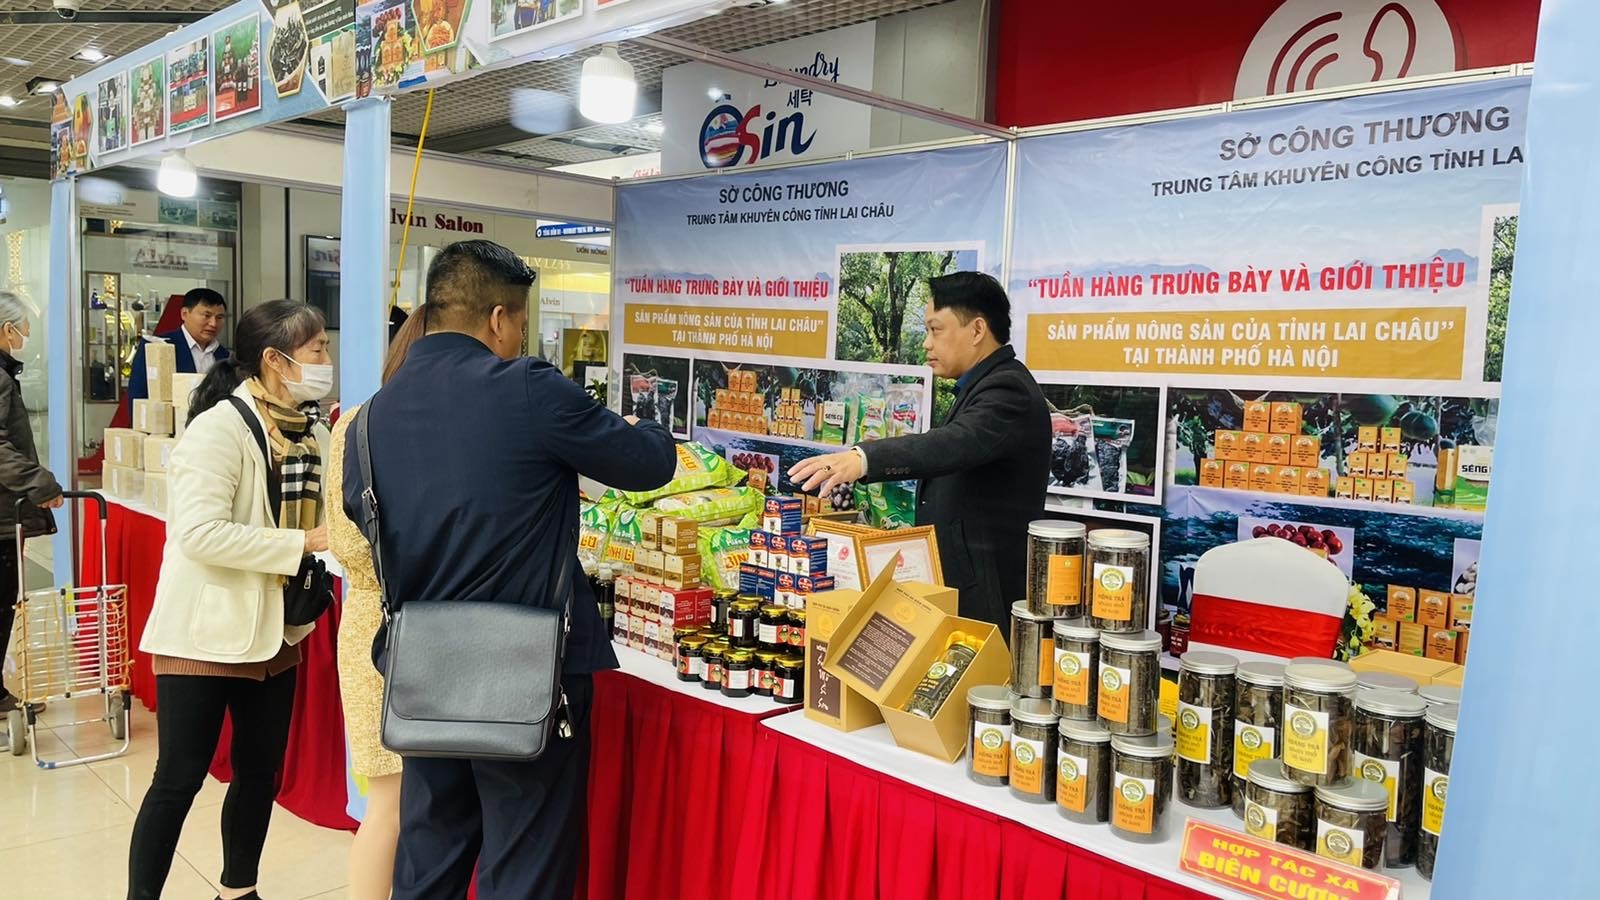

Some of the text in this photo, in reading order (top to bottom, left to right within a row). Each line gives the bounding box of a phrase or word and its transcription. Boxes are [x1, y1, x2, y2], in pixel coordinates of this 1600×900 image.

[787, 88, 813, 108] 세탁
[1219, 106, 1510, 160] SỞ CÔNG THƯƠNG
[1152, 146, 1524, 196] TRUNG TÂM KHUYÊN CÔNG TỈNH LA
[719, 180, 848, 203] SỞ CÔNG THƯƠNG
[391, 208, 484, 233] lvin Salon
[687, 213, 716, 225] TRUNG
[718, 210, 738, 223] TÂM
[782, 207, 811, 221] CÔNG
[840, 207, 858, 219] LAI
[861, 202, 894, 218] CHÂU
[657, 275, 682, 294] HÀNG
[686, 278, 719, 295] TRƯNG
[722, 276, 743, 296] BÀY
[747, 276, 761, 296] VÀ
[765, 276, 789, 297] GIỚI
[793, 276, 829, 301] THIỆU
[1091, 271, 1143, 296] HÀNG
[1150, 270, 1220, 295] TRƯNG
[1228, 265, 1272, 293] BÀY
[1280, 263, 1311, 291] VÀ
[1320, 259, 1372, 290] GIỚI
[1383, 256, 1465, 293] THIỆU
[678, 311, 701, 326] NÔNG
[770, 317, 786, 331] LAI
[1047, 320, 1077, 340] SẢN
[1083, 317, 1130, 340] PHẨM
[1136, 320, 1184, 341] NÔNG
[1189, 318, 1225, 341] SẢN
[1232, 317, 1271, 341] CỦA
[1278, 317, 1326, 341] TỈNH
[1333, 321, 1366, 341] LAI
[672, 329, 773, 351] TẠI THÀNH PHỐ HÀ NỘI
[1123, 342, 1338, 371] TẠI THÀNH PHỐ HÀ NỘI
[1198, 851, 1262, 885] BIÊN
[1212, 838, 1261, 859] HỢP
[1268, 855, 1317, 878] TÁC
